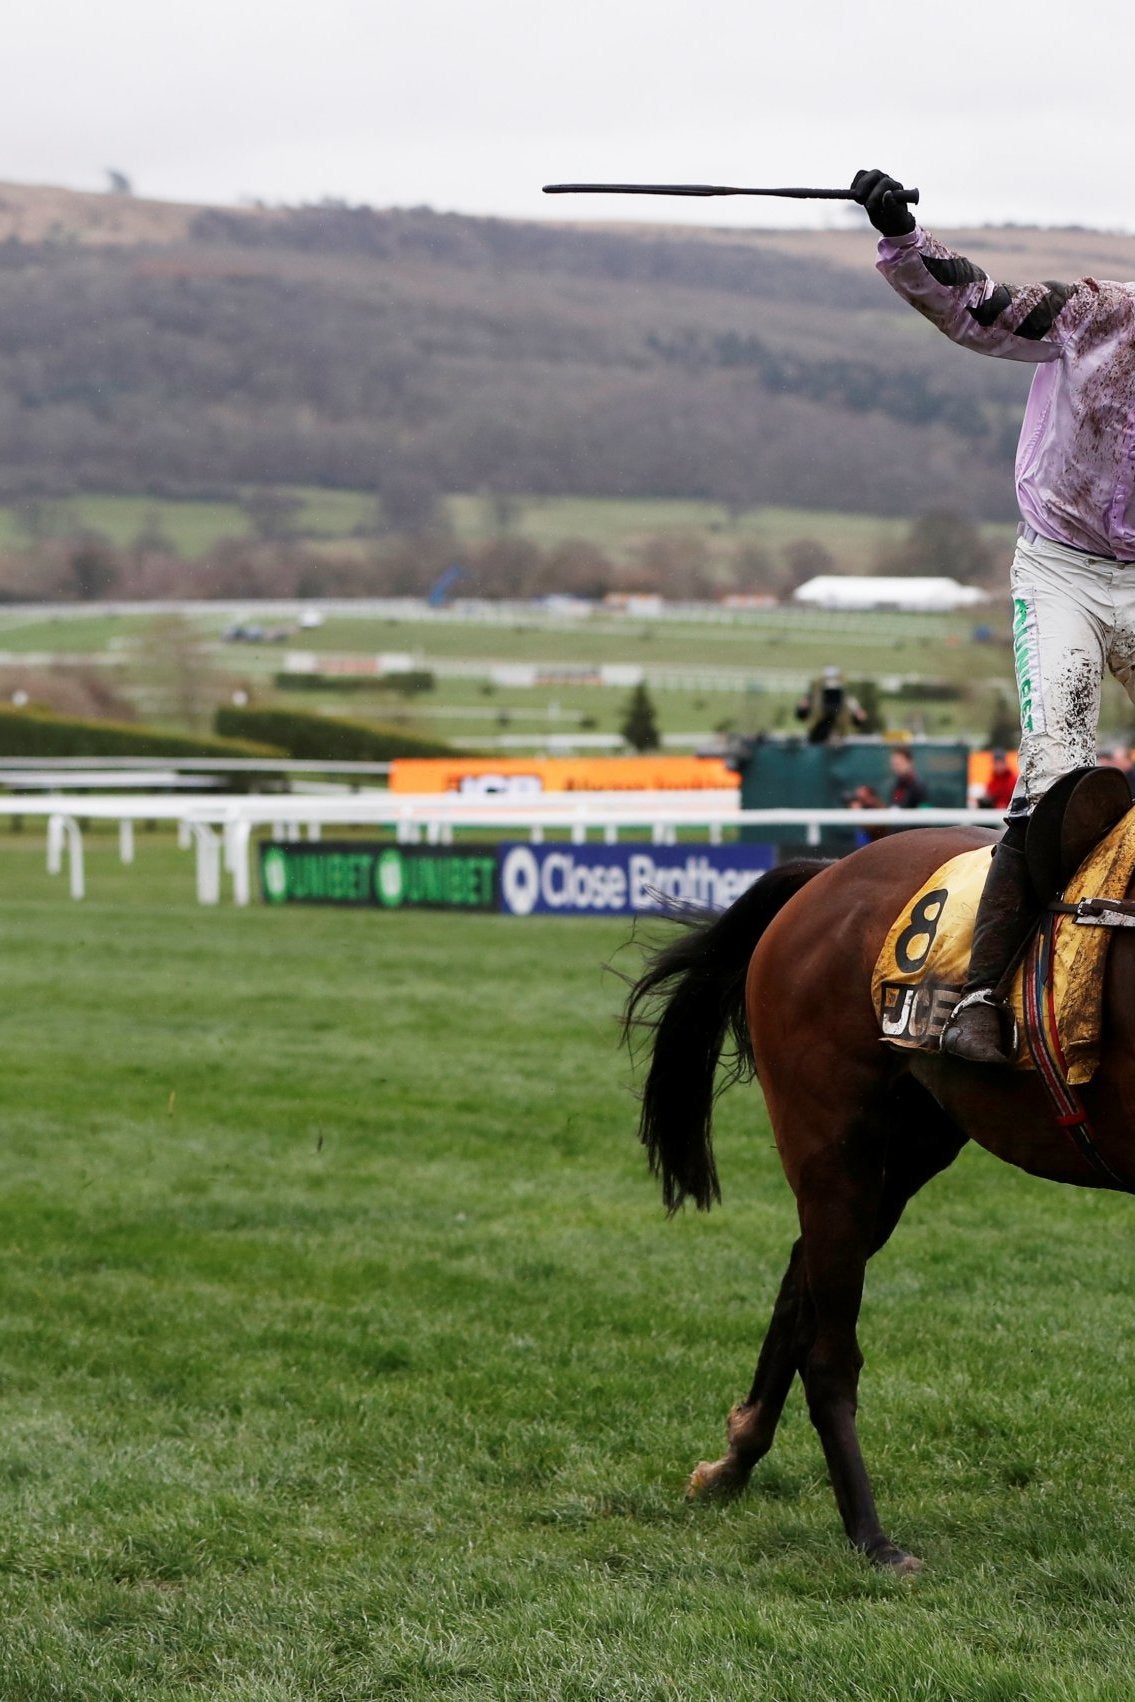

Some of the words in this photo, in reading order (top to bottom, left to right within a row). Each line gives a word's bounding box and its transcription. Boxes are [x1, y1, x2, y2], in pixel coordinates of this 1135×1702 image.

[288, 854, 372, 898] UNIBET
[404, 856, 494, 903] UNIBET
[541, 852, 626, 909] Close
[629, 854, 766, 912] Brother
[895, 888, 949, 974] 8
